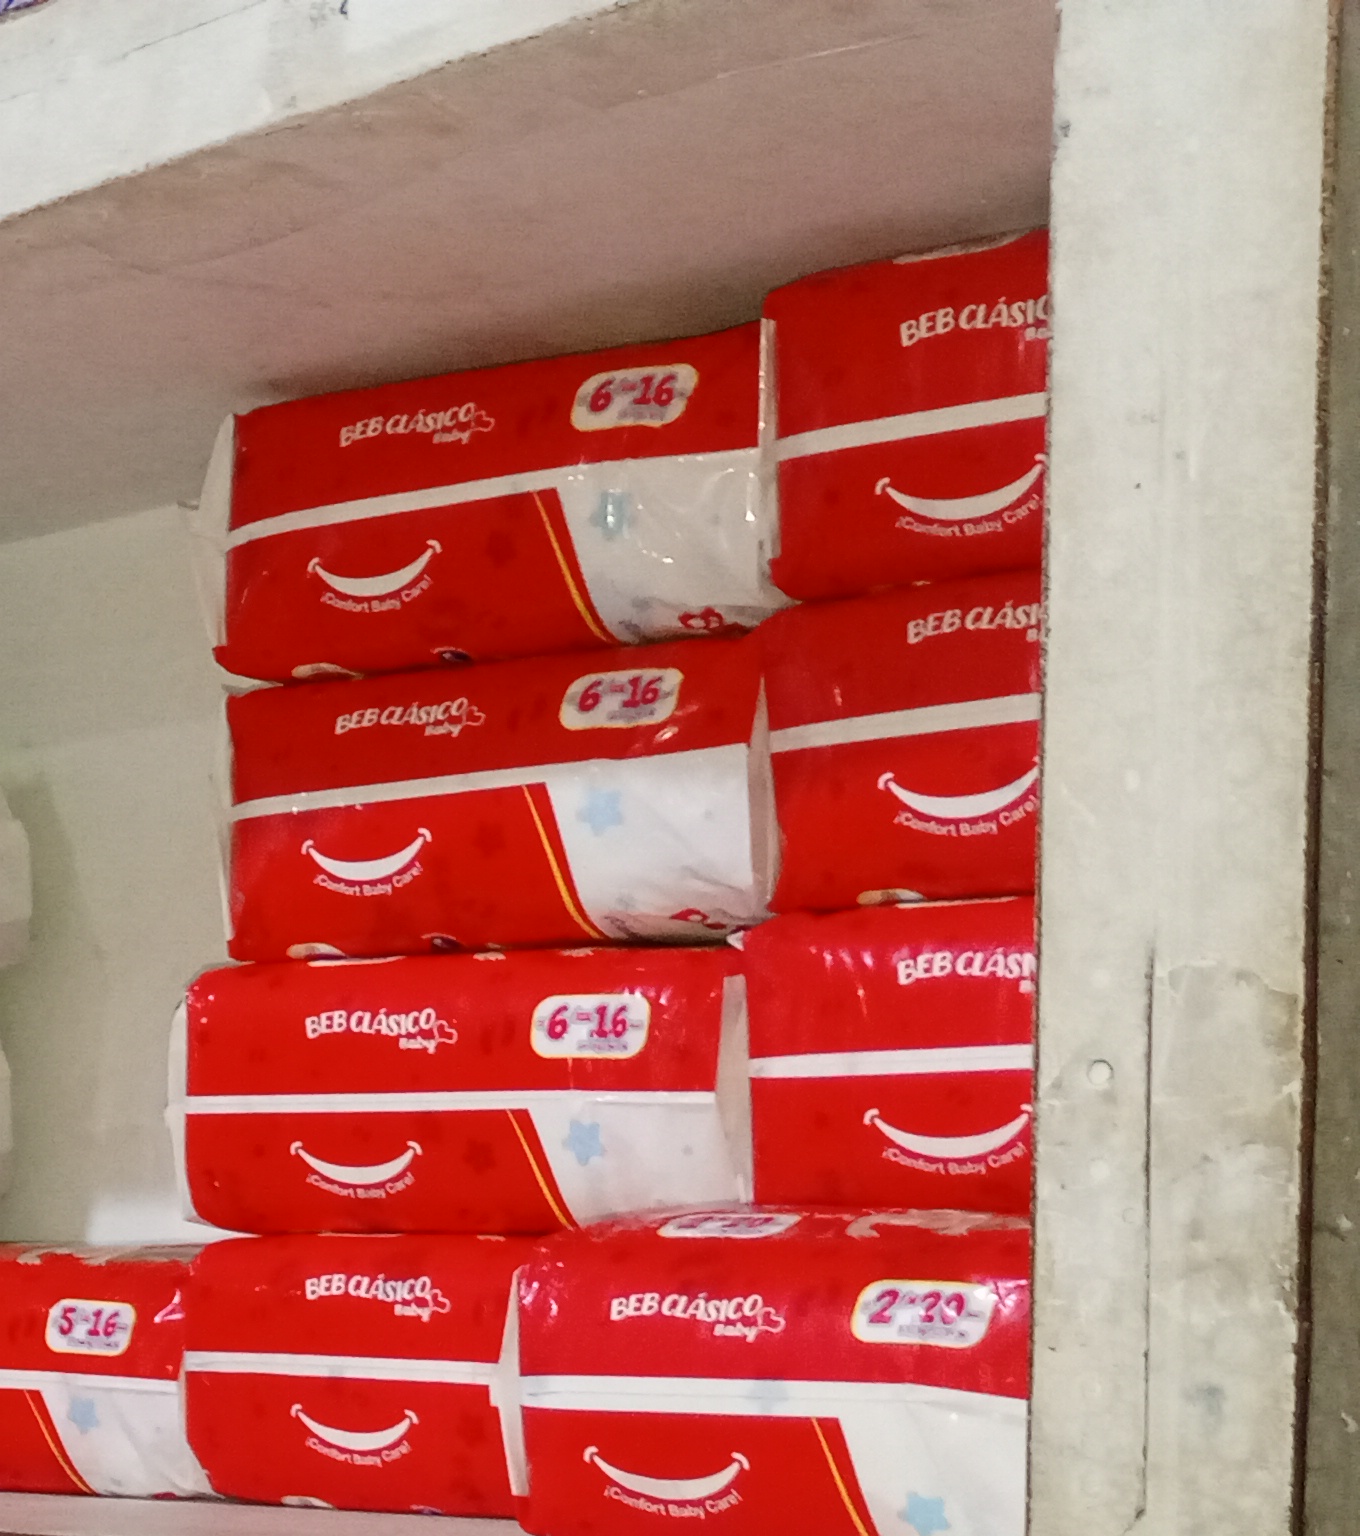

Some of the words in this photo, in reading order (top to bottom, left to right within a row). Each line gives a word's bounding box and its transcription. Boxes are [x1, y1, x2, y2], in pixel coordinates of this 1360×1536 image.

[900, 306, 955, 347] BEB
[339, 416, 384, 447] BEB
[385, 401, 477, 435] CLÁSICO
[962, 518, 1004, 537] Baby
[906, 609, 962, 645] BEB
[334, 707, 380, 736] BEB
[380, 696, 469, 726] CLÁSICO
[958, 818, 998, 838] Baby
[897, 951, 953, 986] BEB
[305, 1009, 347, 1040] BEB
[349, 1006, 436, 1038] CLÁSICO
[305, 1273, 347, 1301] BEB
[347, 1273, 432, 1302] CLÁSICO
[609, 1291, 659, 1322] BEB
[661, 1291, 763, 1323] CLÁSICO
[667, 1501, 705, 1520] Baby
